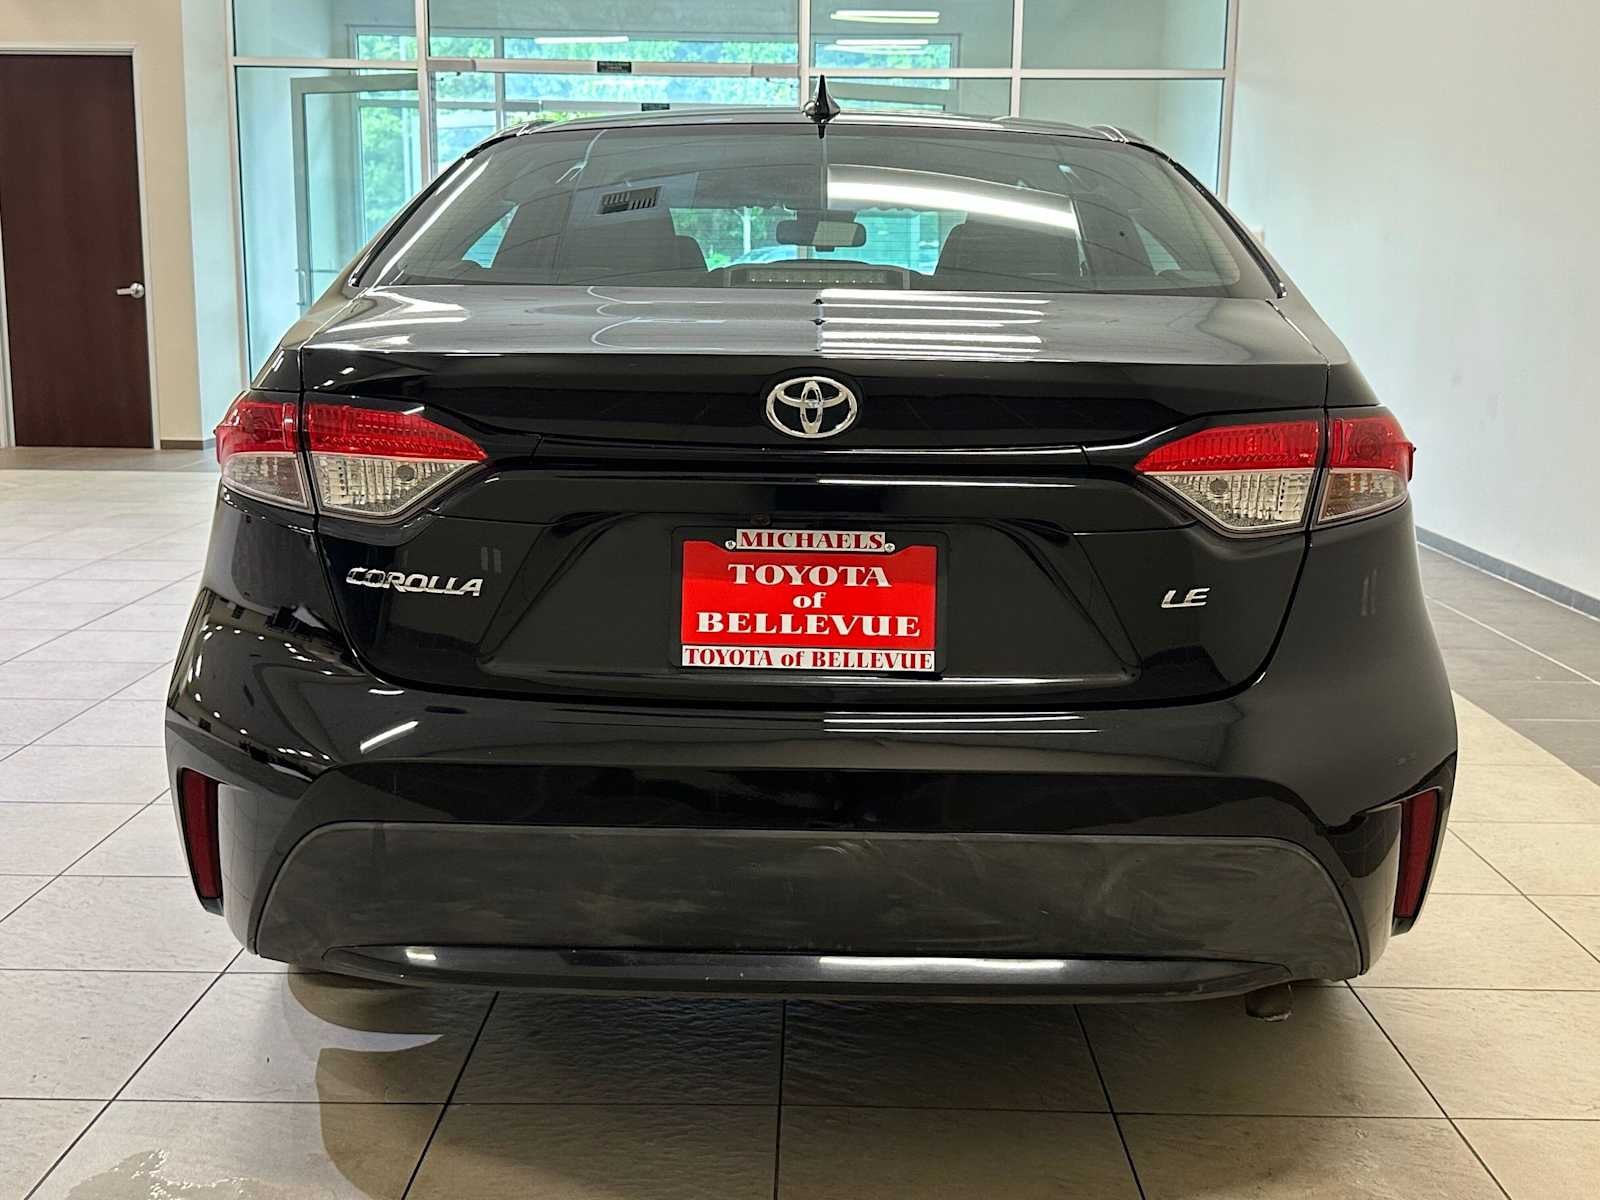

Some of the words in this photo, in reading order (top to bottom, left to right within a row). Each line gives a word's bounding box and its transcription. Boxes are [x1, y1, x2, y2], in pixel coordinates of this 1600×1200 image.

[740, 531, 883, 549] MICHAELS
[345, 567, 484, 597] COROLLA
[728, 563, 892, 588] TOYOTA
[792, 591, 827, 609] of
[1161, 587, 1210, 608] LE
[696, 612, 921, 637] BELLEVUE
[685, 648, 774, 666] TOYOTA
[781, 650, 804, 667] of
[812, 650, 933, 670] BELLEVUE
